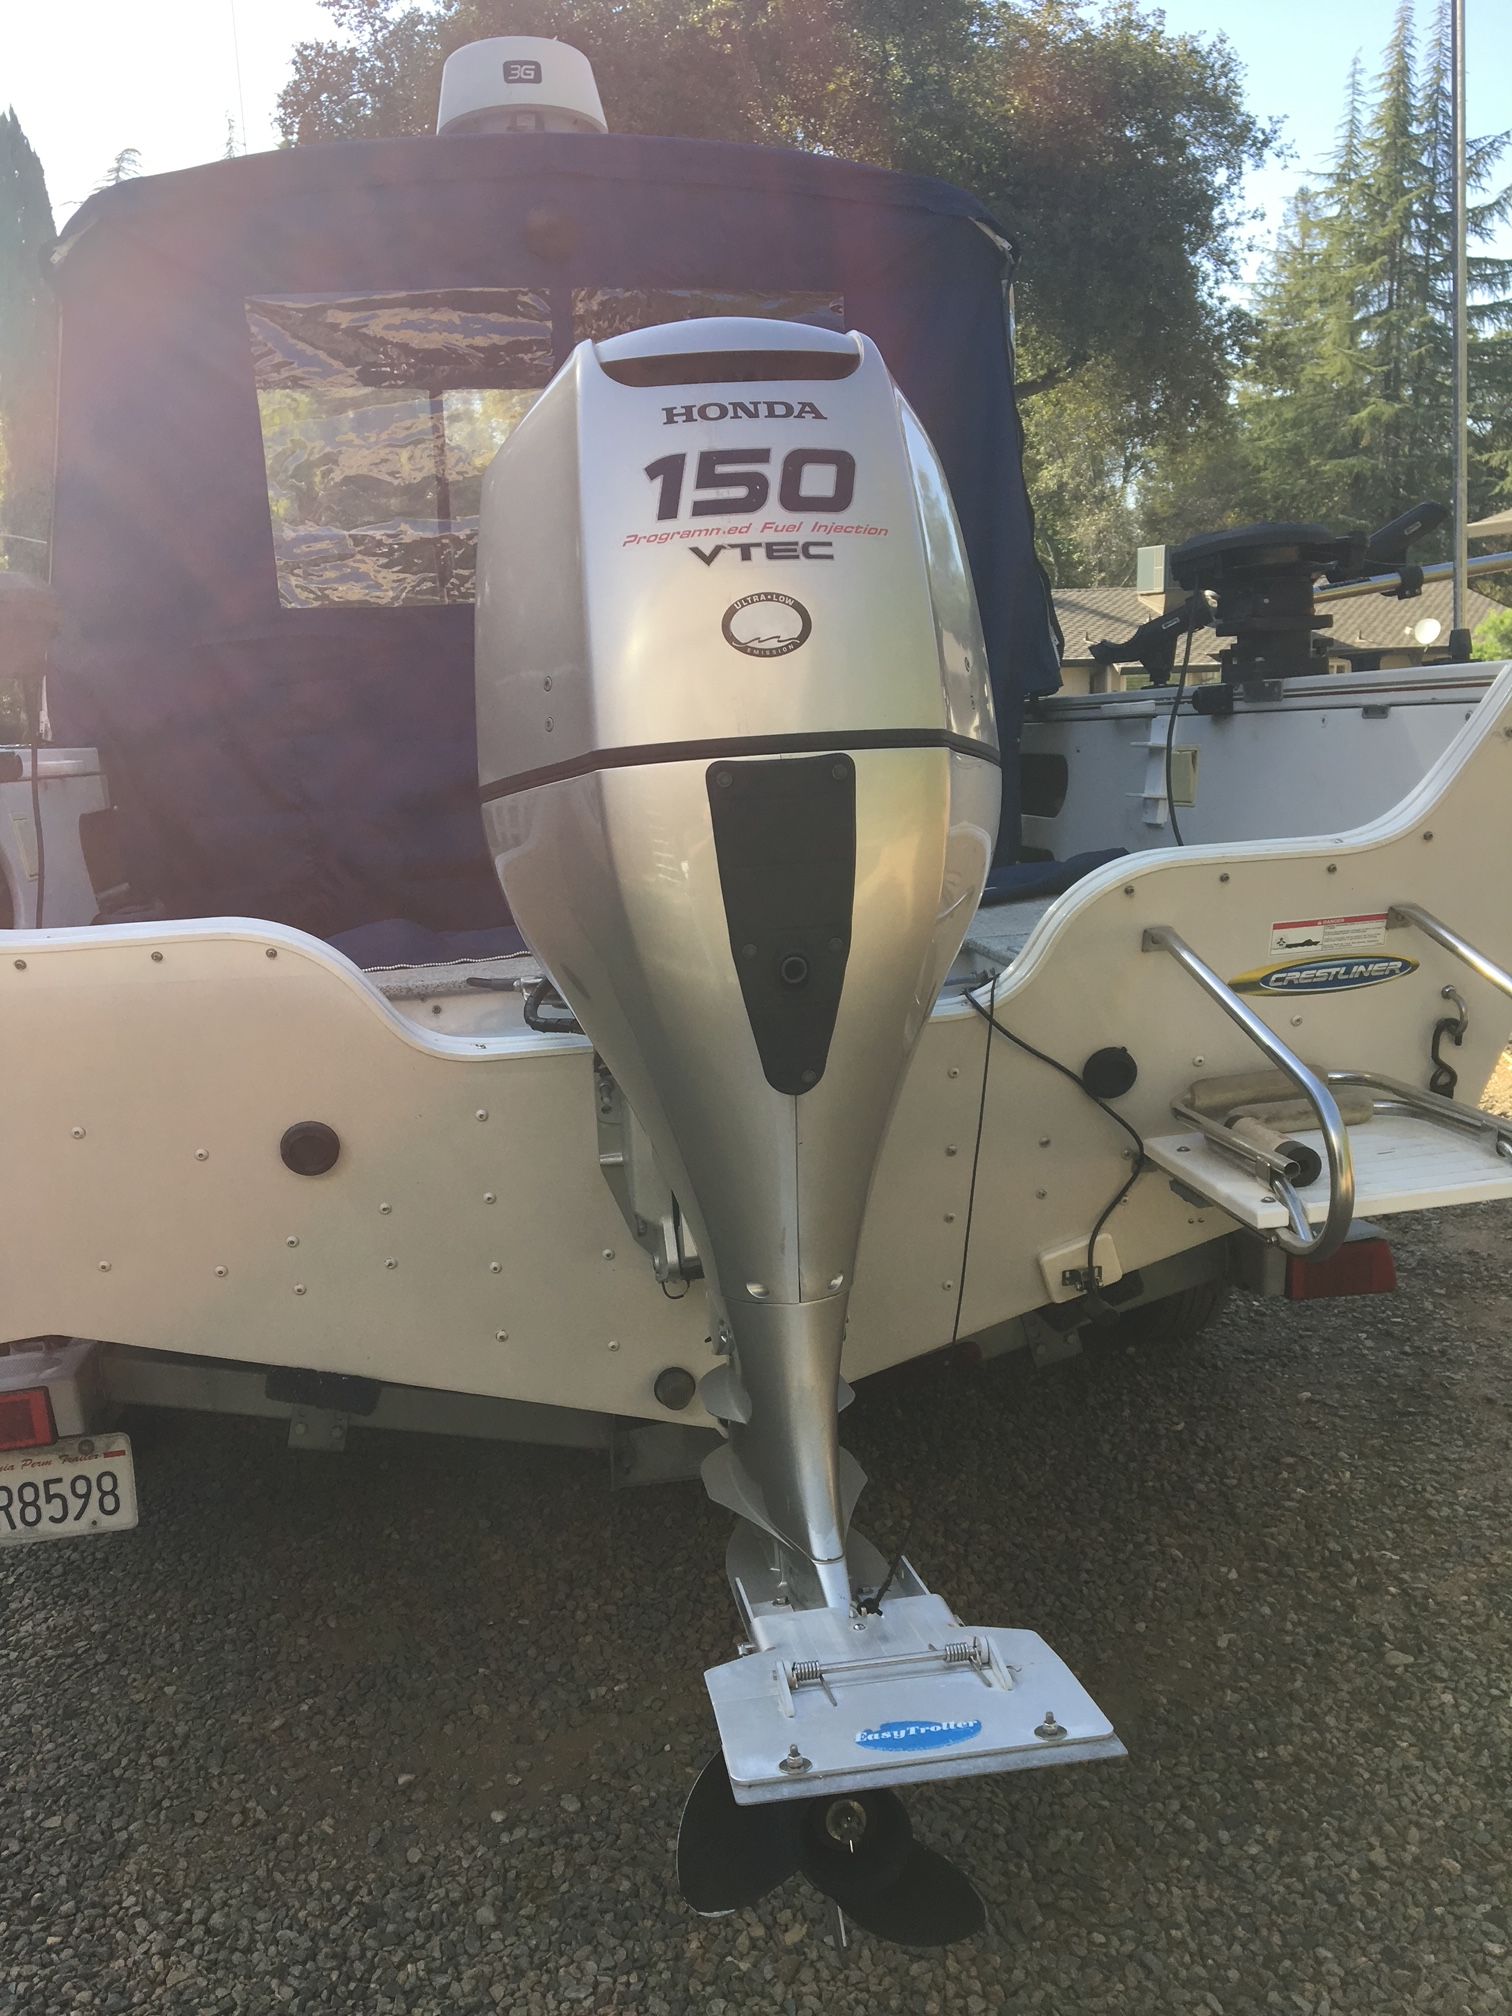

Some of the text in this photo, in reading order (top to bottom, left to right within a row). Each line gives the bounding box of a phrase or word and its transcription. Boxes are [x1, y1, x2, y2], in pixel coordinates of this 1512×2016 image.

[508, 64, 536, 80] 3G
[661, 401, 828, 425] HONDA
[644, 448, 856, 521] 150
[759, 521, 804, 534] Fuel
[810, 521, 889, 537] Injection
[688, 541, 835, 567] VTEC
[746, 643, 795, 656] EMISSION
[1268, 961, 1402, 987] CRESTLINER
[21, 1458, 52, 1470] Perm
[0, 1470, 121, 1531] R8598
[854, 1720, 979, 1742] EasyTroller
